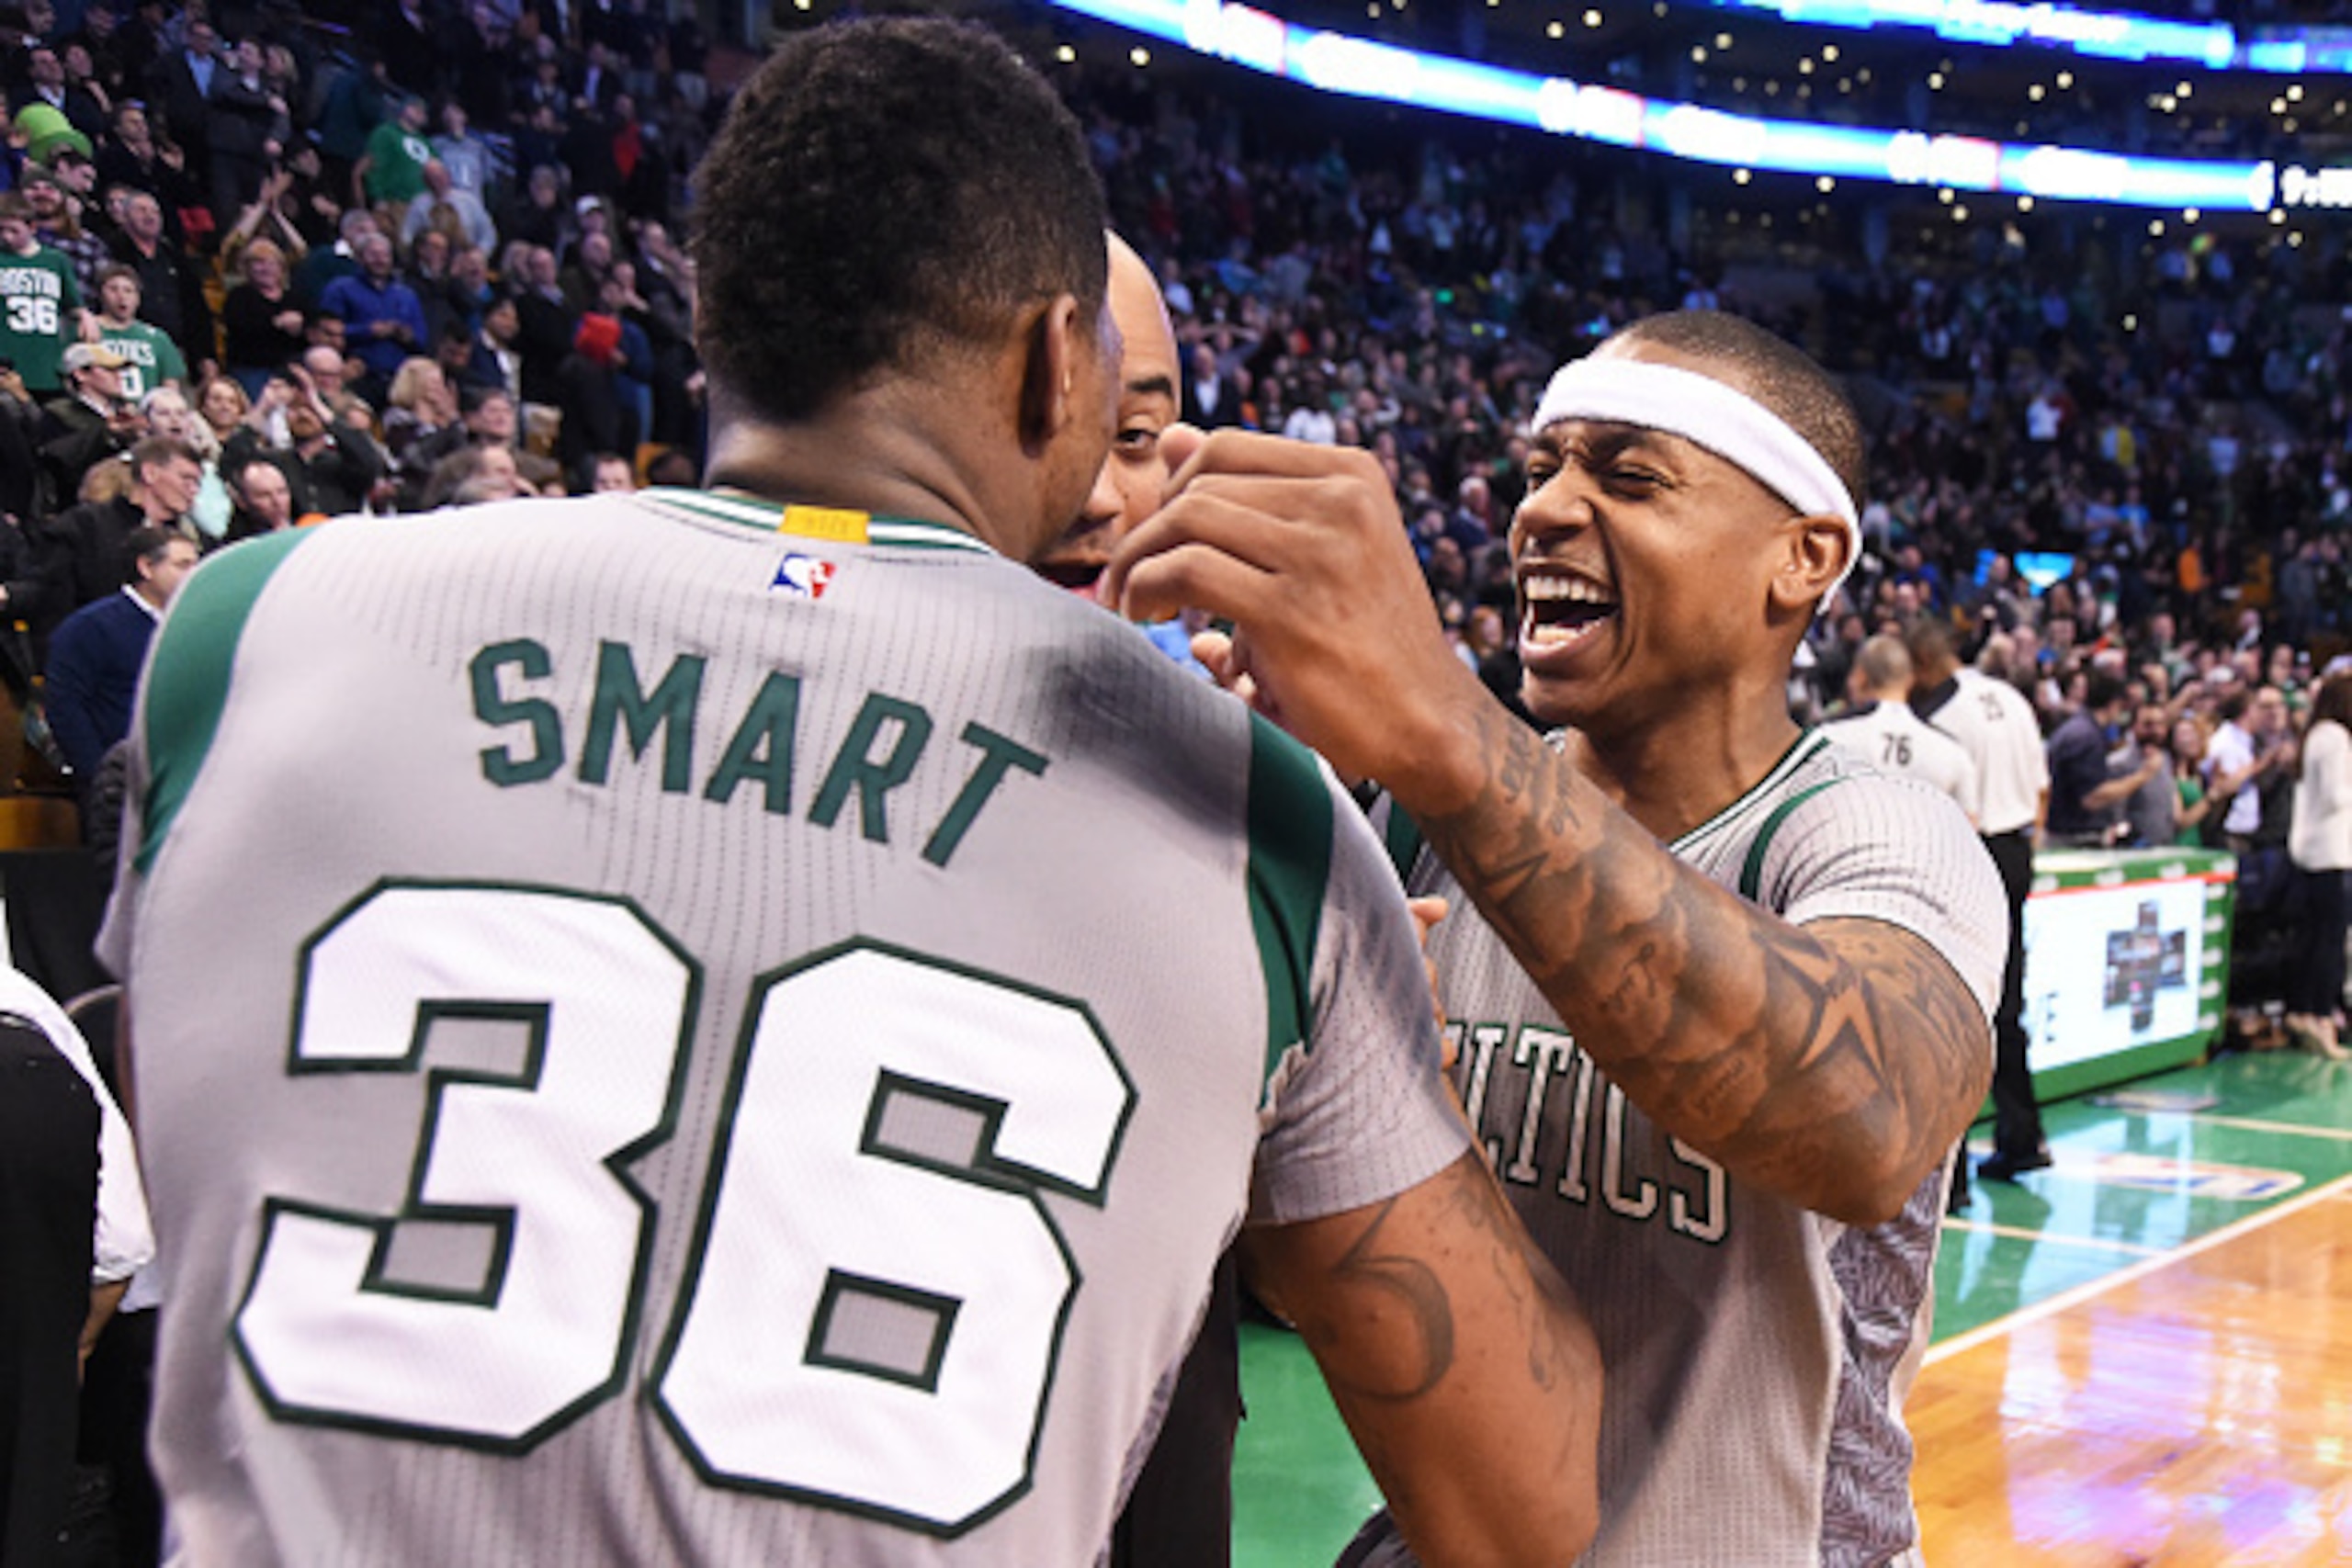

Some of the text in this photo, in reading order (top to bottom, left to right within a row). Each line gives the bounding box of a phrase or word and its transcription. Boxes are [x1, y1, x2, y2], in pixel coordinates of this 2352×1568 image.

[6, 295, 58, 334] 36
[469, 637, 1050, 869] SMART
[1881, 732, 1913, 767] 76
[229, 875, 1139, 1541] 36
